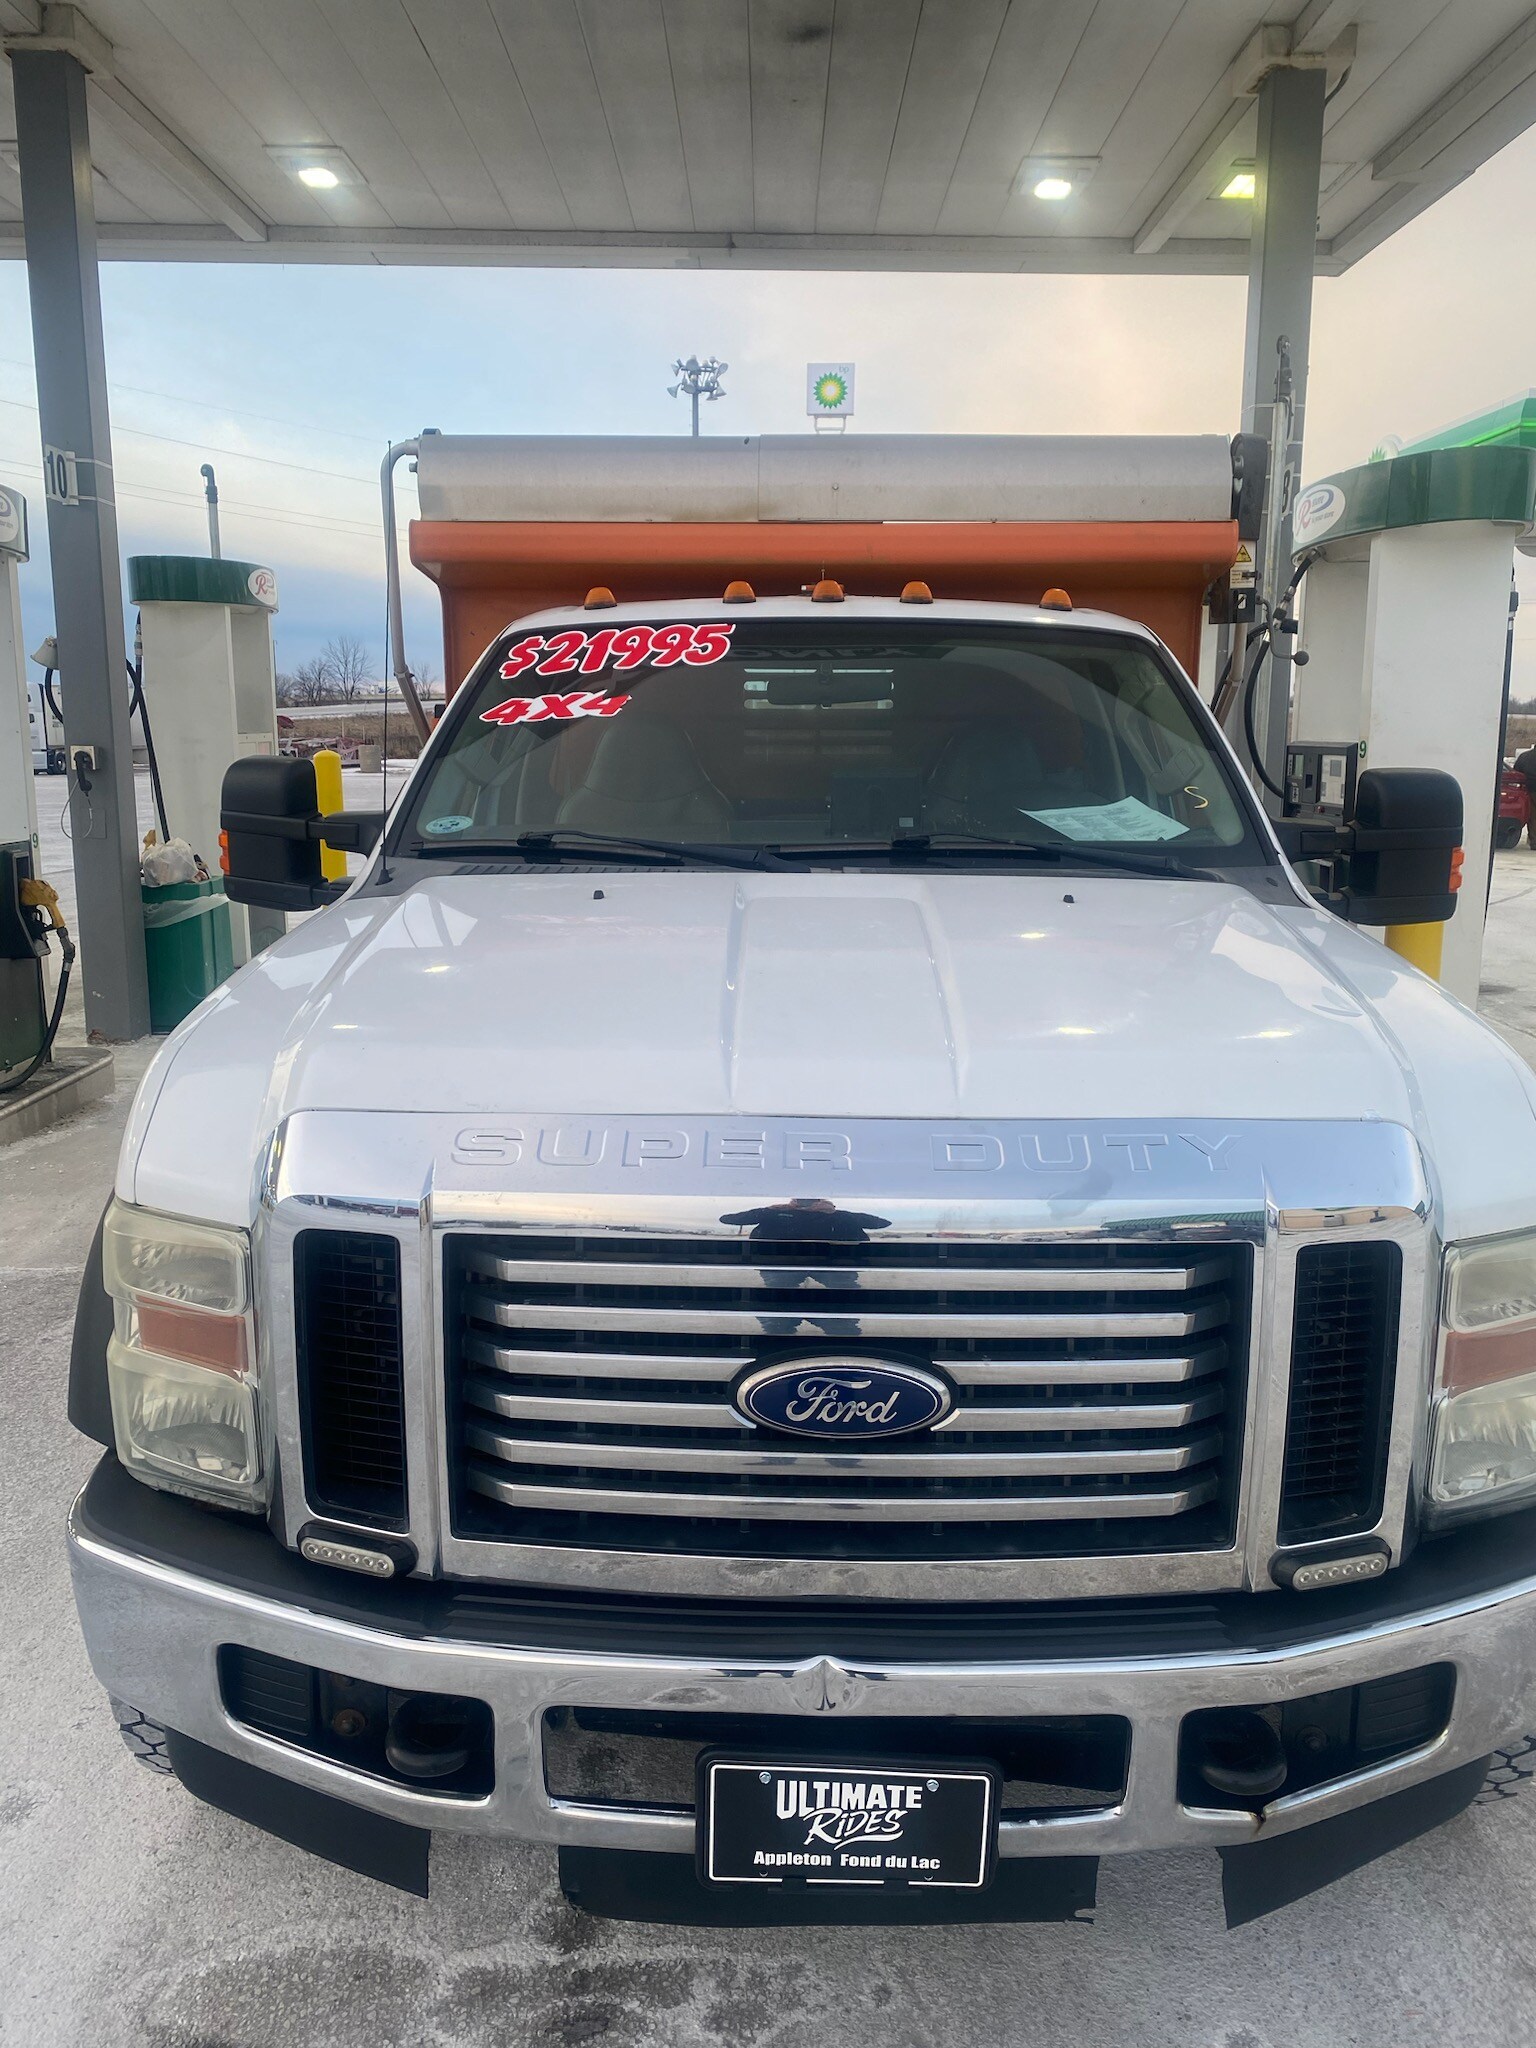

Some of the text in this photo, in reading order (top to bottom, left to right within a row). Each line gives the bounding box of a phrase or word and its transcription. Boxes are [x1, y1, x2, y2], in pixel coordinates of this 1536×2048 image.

[838, 365, 850, 374] bp
[46, 450, 68, 499] 10
[255, 574, 268, 595] R
[499, 623, 736, 679] $21995
[1359, 740, 1368, 759] 9
[31, 832, 39, 849] 9
[450, 1126, 1246, 1173] SUPER DUTY
[785, 1376, 901, 1424] Ford
[776, 1779, 923, 1820] ULTIMATE
[753, 1850, 941, 1870] Appleton Fond du Lac
